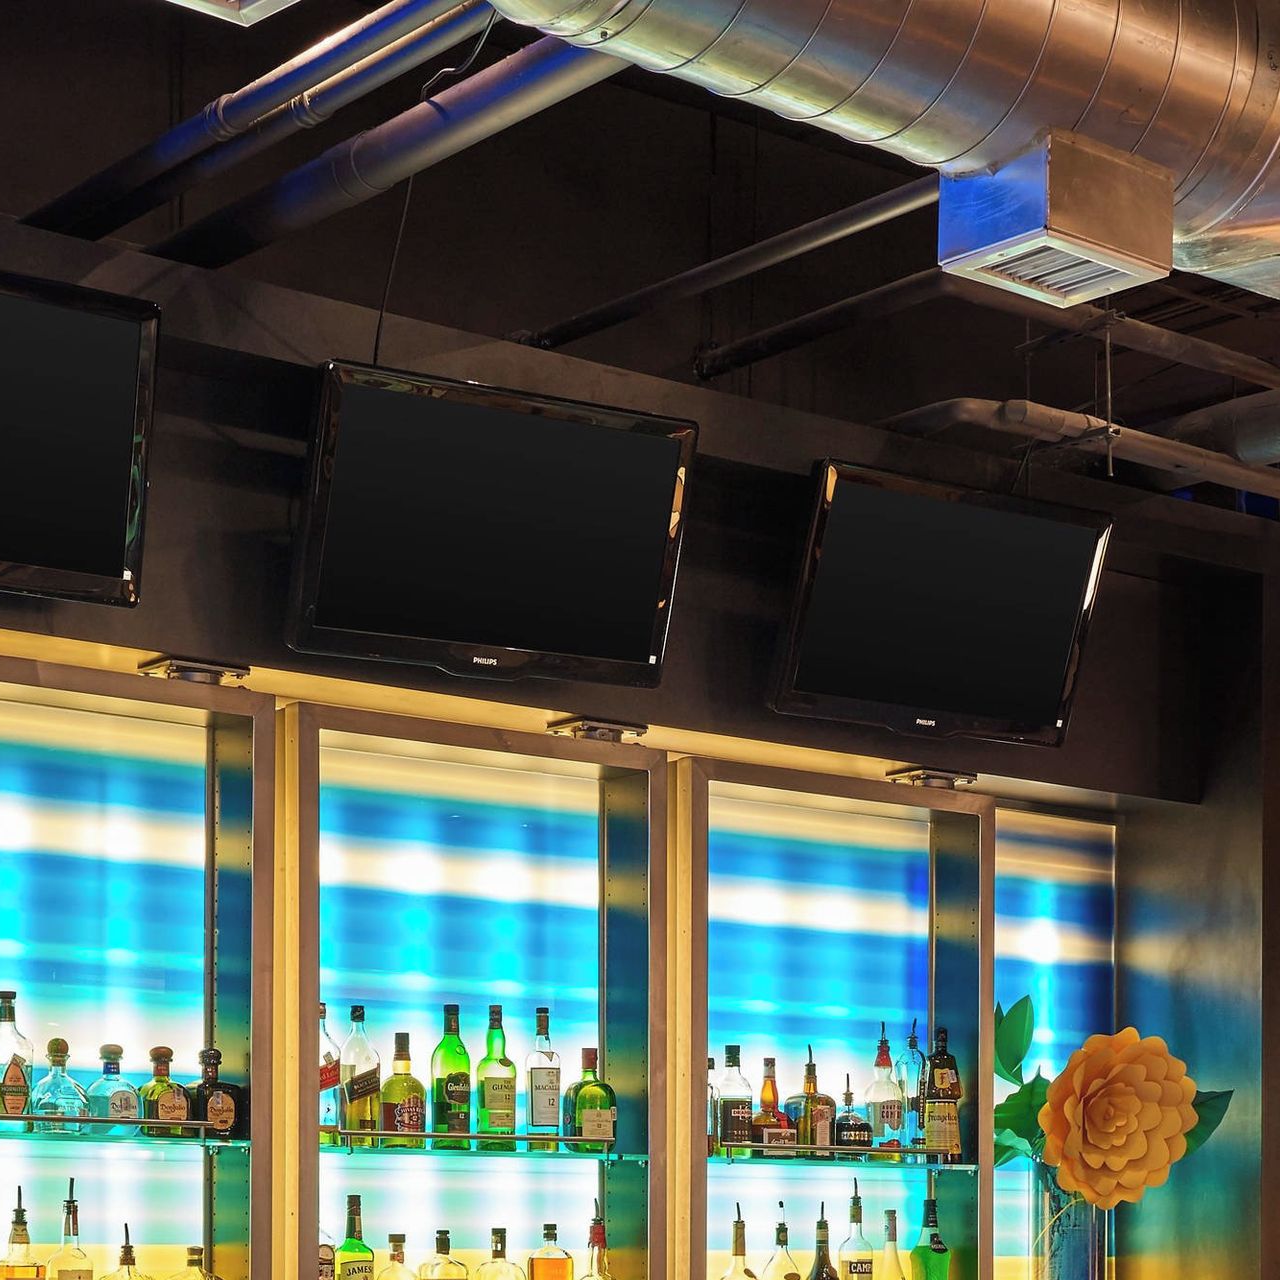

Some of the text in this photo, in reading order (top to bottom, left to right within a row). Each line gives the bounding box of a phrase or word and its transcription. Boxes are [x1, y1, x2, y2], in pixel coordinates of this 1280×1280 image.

[473, 656, 497, 666] PHILIPS
[548, 1098, 555, 1106] 12
[928, 1110, 958, 1122] Frangelico
